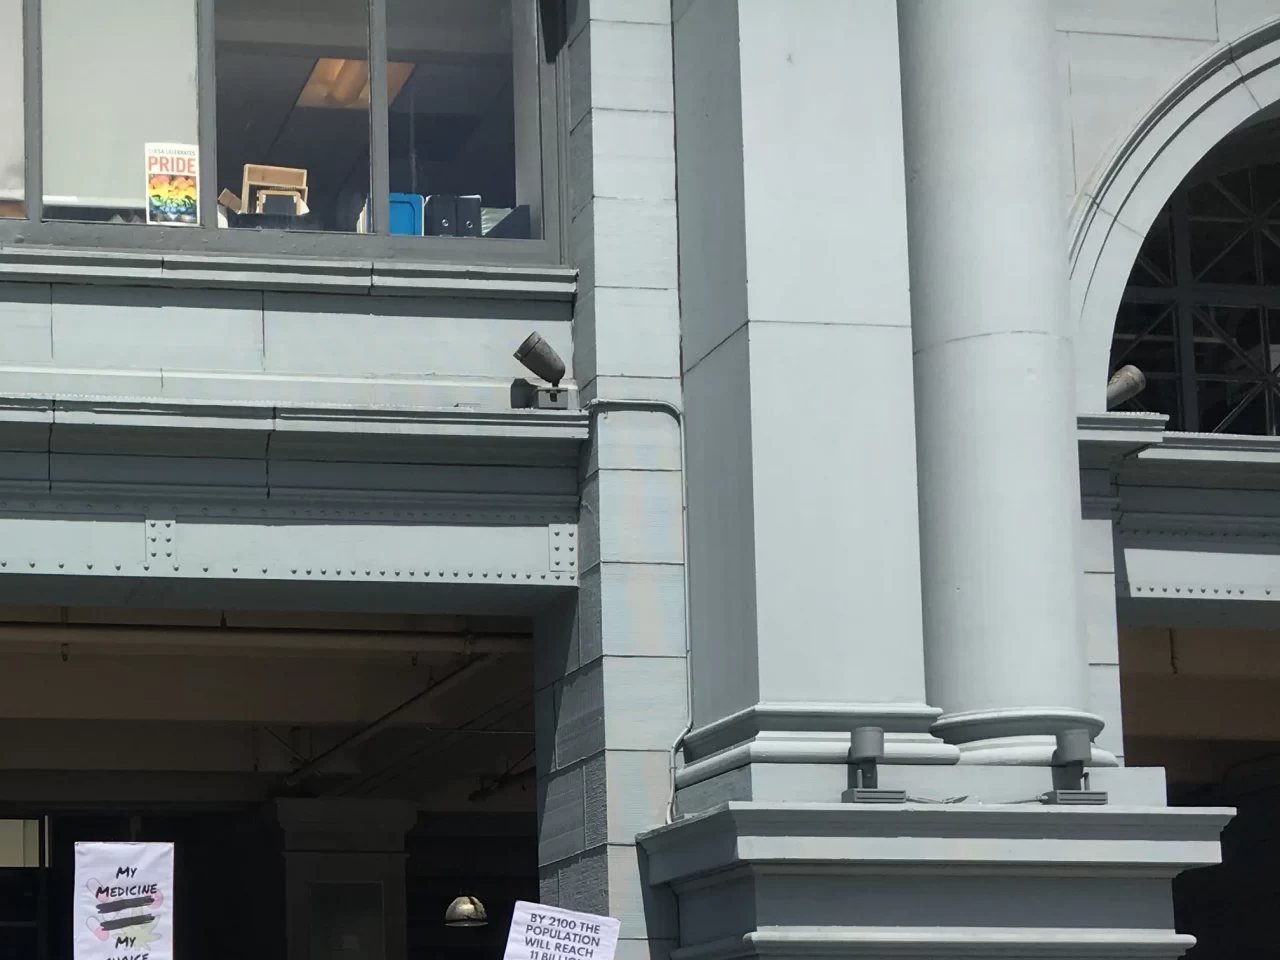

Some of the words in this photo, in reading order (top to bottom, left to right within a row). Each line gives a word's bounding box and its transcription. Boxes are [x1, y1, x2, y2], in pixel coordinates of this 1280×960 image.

[148, 156, 196, 174] PRIDE
[116, 866, 137, 879] MY
[96, 884, 158, 899] MEDICINE
[530, 913, 546, 925] BY
[549, 917, 576, 930] 2100
[580, 921, 601, 935] THE
[115, 936, 136, 948] MY
[525, 924, 601, 948] POPULATION
[525, 936, 551, 950] WILL
[554, 942, 594, 959] REACH
[530, 950, 539, 960] 11
